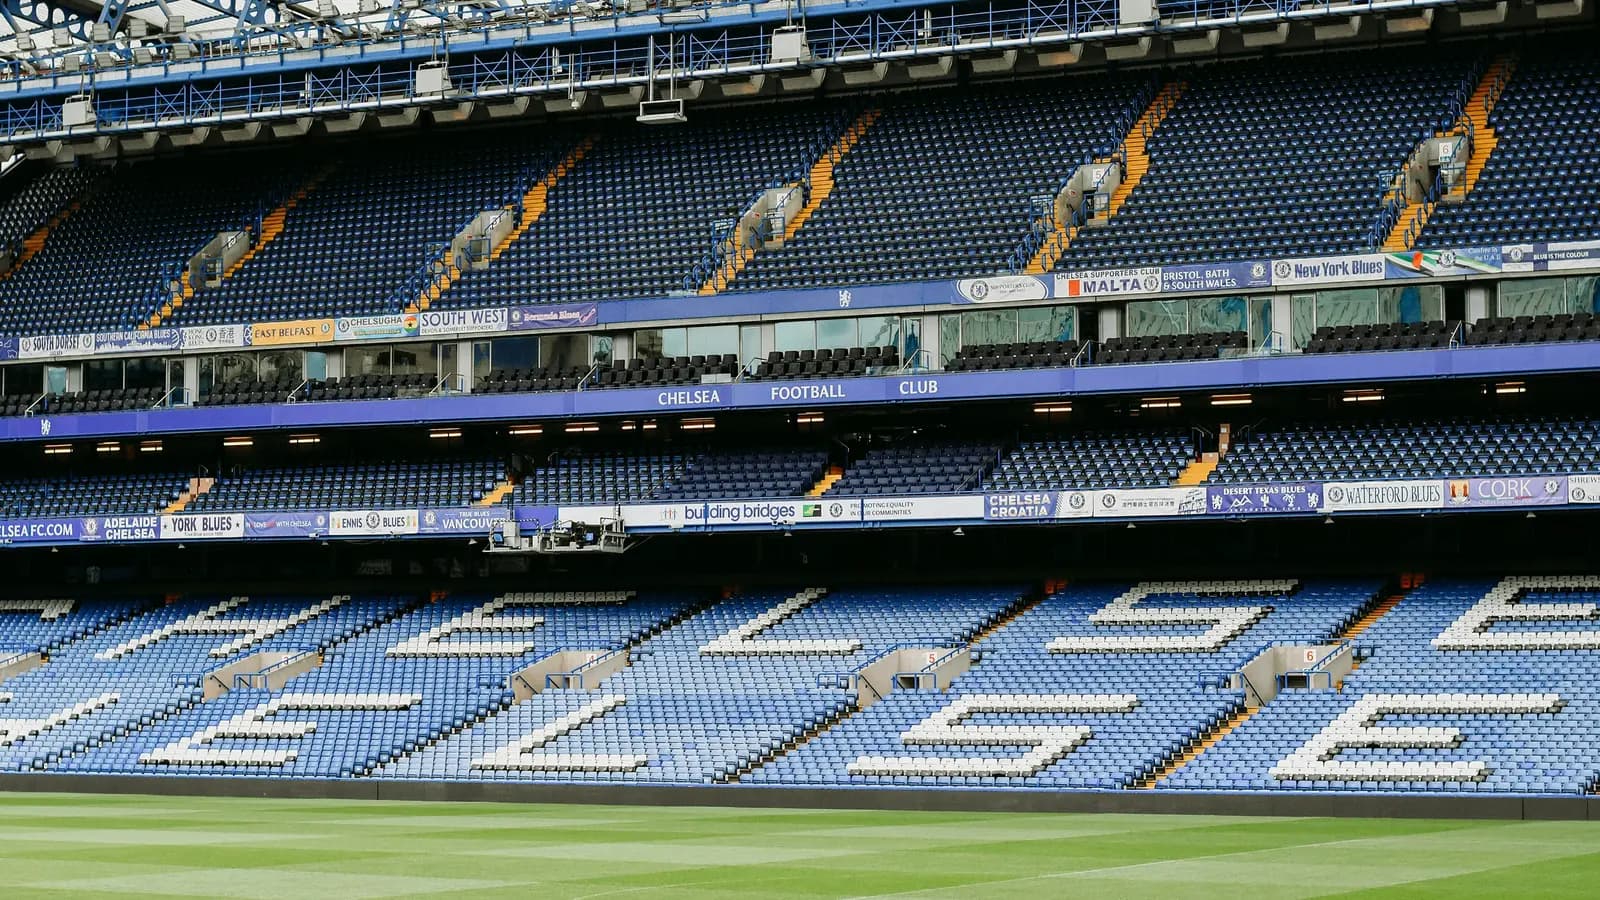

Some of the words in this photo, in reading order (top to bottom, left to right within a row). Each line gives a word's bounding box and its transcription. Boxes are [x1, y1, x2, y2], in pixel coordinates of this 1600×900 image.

[1056, 272, 1089, 280] CHELSEA
[1090, 270, 1138, 278] SUPPORTERS
[1206, 269, 1229, 278] BATH
[1294, 264, 1320, 278] New
[1322, 262, 1350, 276] York
[1352, 260, 1382, 275] Blues
[1083, 278, 1141, 293] MALTA
[1172, 281, 1204, 290] SOUTH
[1206, 278, 1236, 288] WALES
[422, 313, 466, 327] SOUTH
[472, 309, 506, 324] WEST
[559, 310, 580, 319] Blues
[350, 317, 402, 326] CHELSUGHA
[96, 332, 124, 342] SOUTHERN
[124, 329, 154, 340] CALIFORNIA
[154, 328, 170, 339] BLUES
[255, 329, 277, 338] EAST
[279, 327, 316, 337] BELFAST
[33, 336, 54, 351] SOUTH
[56, 335, 80, 350] DORSET
[658, 390, 720, 405] CHELSEA
[772, 384, 846, 400] FOOTBALL
[900, 380, 938, 394] CLUB
[1346, 484, 1408, 504] WATERFORD
[1411, 485, 1440, 502] BLUES
[1478, 480, 1532, 498] CORK
[990, 494, 1051, 505] CHELSEA
[685, 505, 740, 521] buiding
[744, 504, 795, 521] bridges
[990, 506, 1048, 517] CROATIA
[104, 517, 157, 528] ADELAIDE
[172, 517, 197, 532] YORK
[202, 516, 232, 531] BLUES
[342, 518, 362, 528] ENNIS
[383, 516, 405, 527] BLUES
[443, 518, 505, 528] VANCOUV
[0, 525, 28, 537] LSEA
[106, 528, 156, 540] CHELSEA
[929, 654, 935, 664] 5
[1307, 650, 1313, 661] 6
